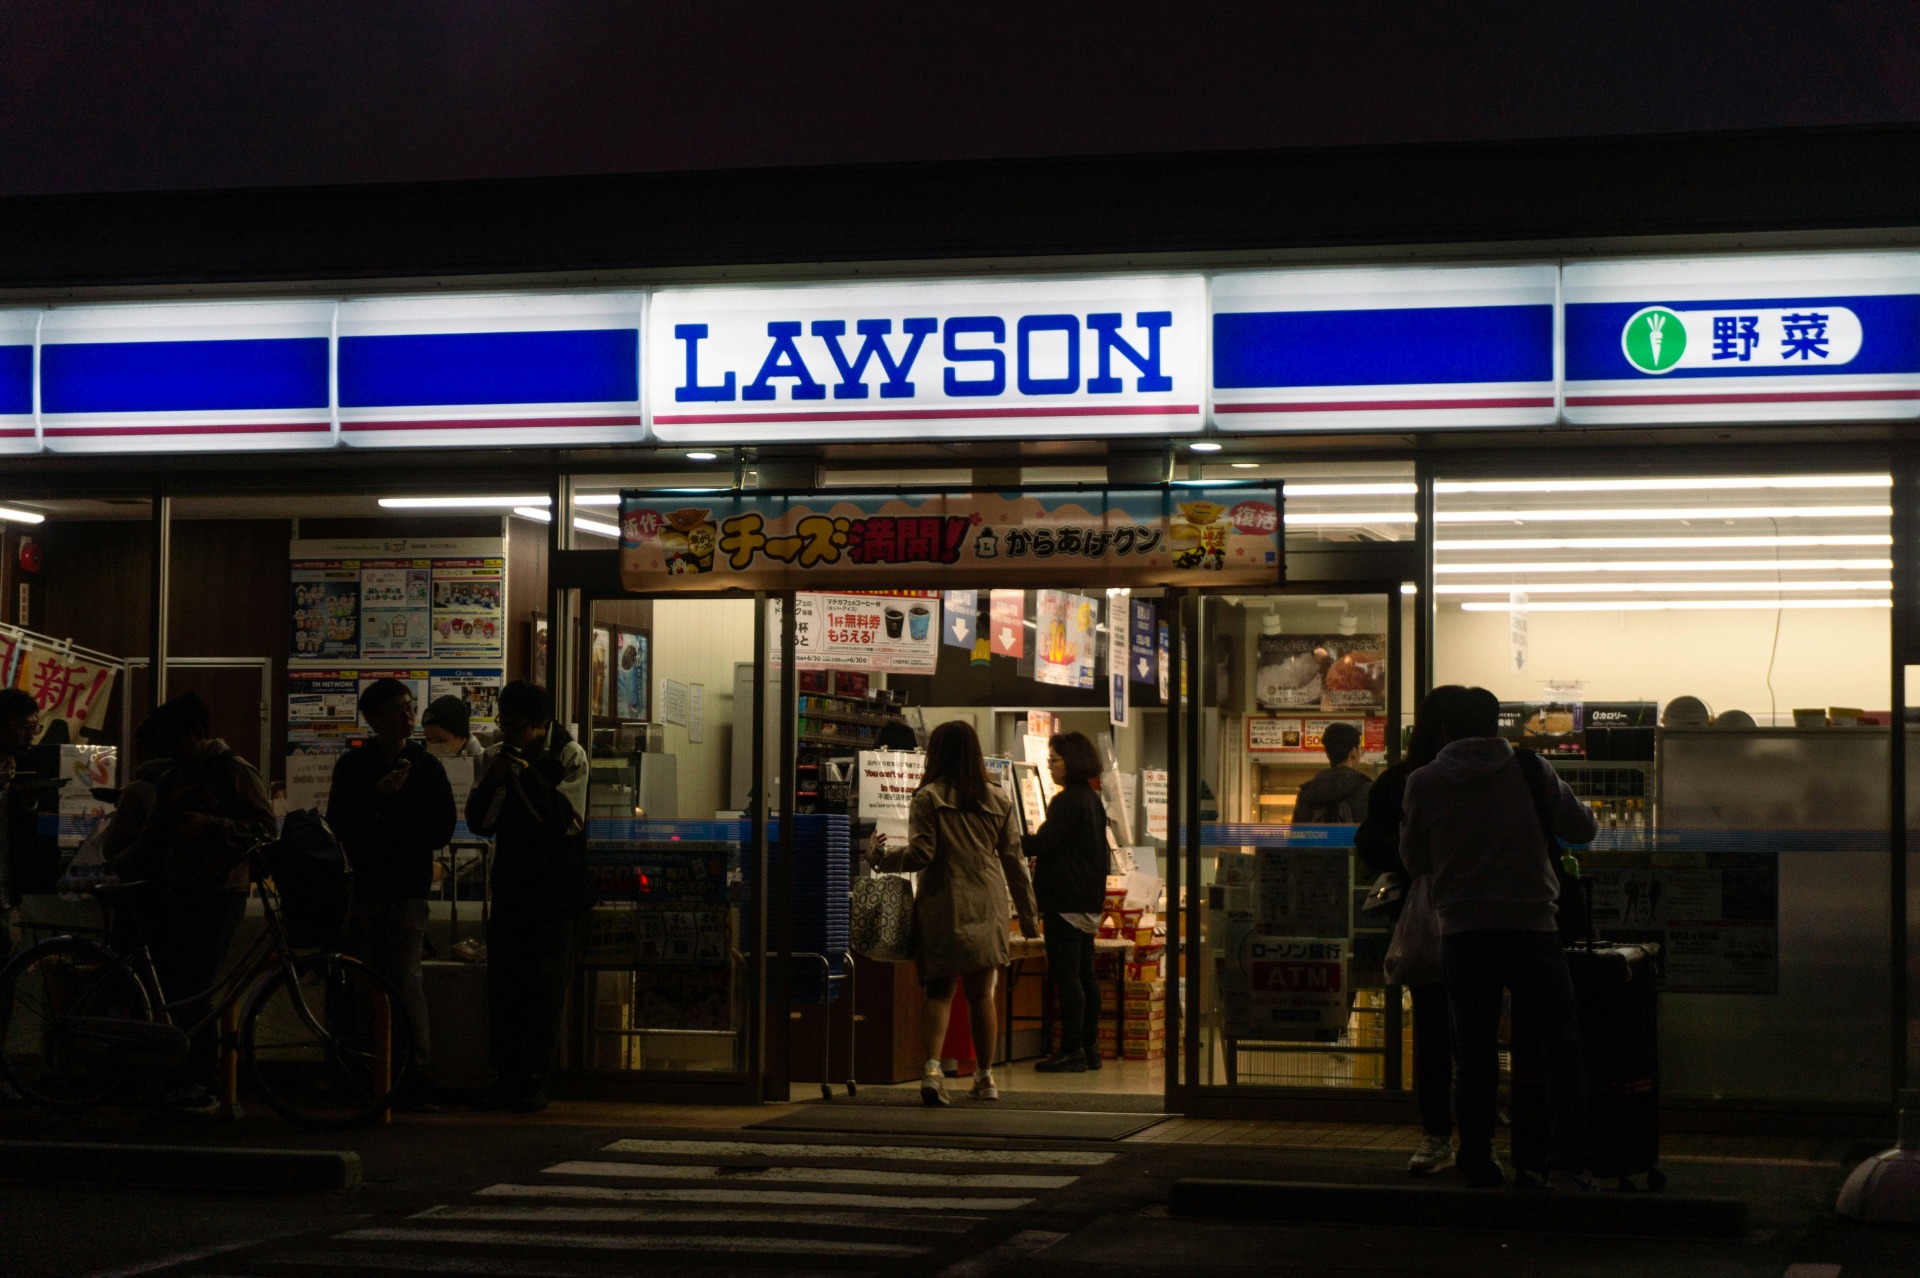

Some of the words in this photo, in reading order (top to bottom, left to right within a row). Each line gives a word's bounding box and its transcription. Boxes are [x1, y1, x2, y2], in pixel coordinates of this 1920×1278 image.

[1711, 312, 1829, 362] 野菜
[675, 311, 1172, 402] LAWSON
[623, 513, 661, 541] 新作
[1235, 506, 1277, 531] 復活
[1006, 526, 1162, 558] からあげクン
[828, 628, 875, 644] もらえる!
[33, 657, 108, 720] 新!
[1252, 943, 1341, 959] ローソン銀行
[1266, 965, 1328, 988] ATM
